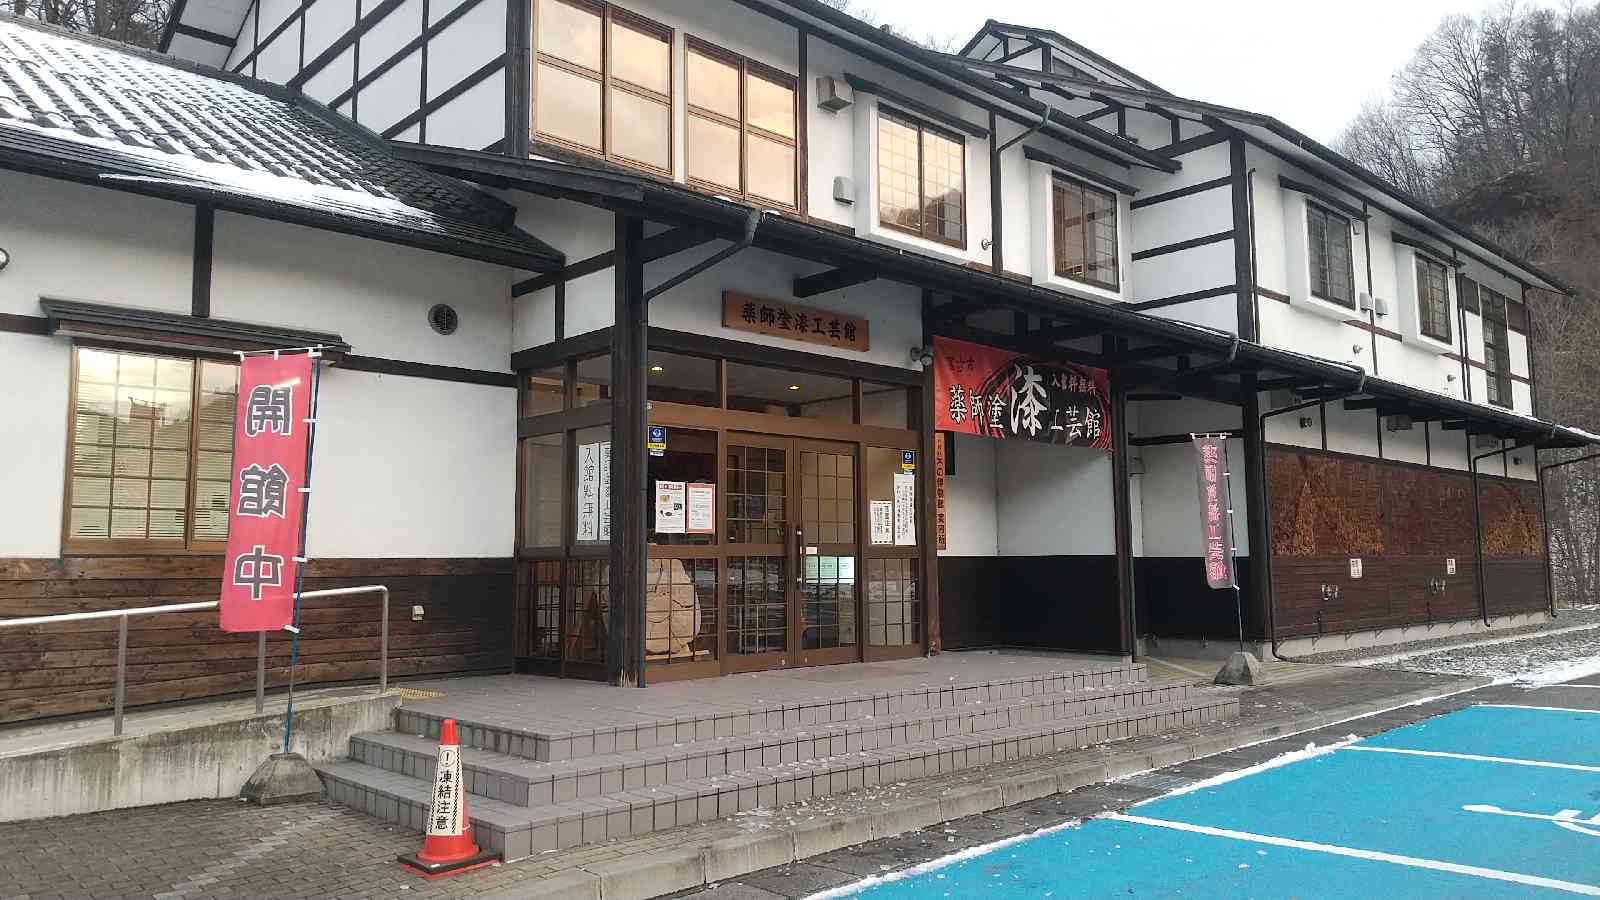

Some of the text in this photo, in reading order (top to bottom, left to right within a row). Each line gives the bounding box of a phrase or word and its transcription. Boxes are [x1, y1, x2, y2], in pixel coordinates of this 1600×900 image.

[741, 300, 857, 342] 薬師塗漆工芸館
[435, 769, 453, 830] 凍結注意
